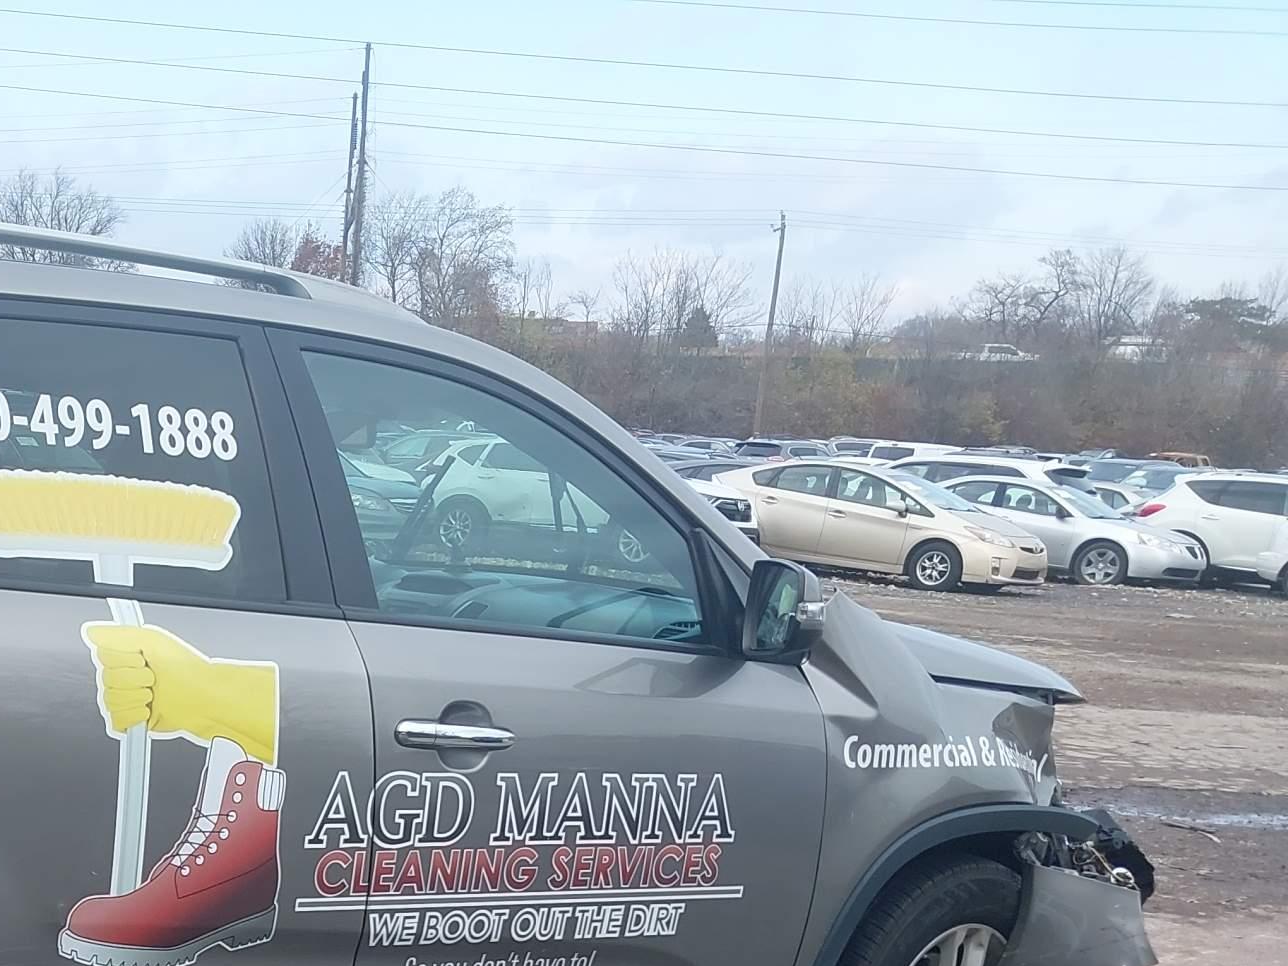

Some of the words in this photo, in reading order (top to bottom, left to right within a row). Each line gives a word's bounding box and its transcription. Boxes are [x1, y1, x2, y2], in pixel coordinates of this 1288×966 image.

[843, 735, 977, 769] Commercial
[979, 736, 996, 767] &
[304, 770, 475, 849] AGD
[489, 773, 735, 846] MANNA
[314, 847, 539, 897] CLEANING
[547, 844, 721, 890] SERVICES
[368, 912, 418, 946] WE
[419, 911, 508, 945] BOOT
[511, 908, 574, 941] OUT
[574, 905, 622, 938] THE
[624, 902, 685, 937] DIRT
